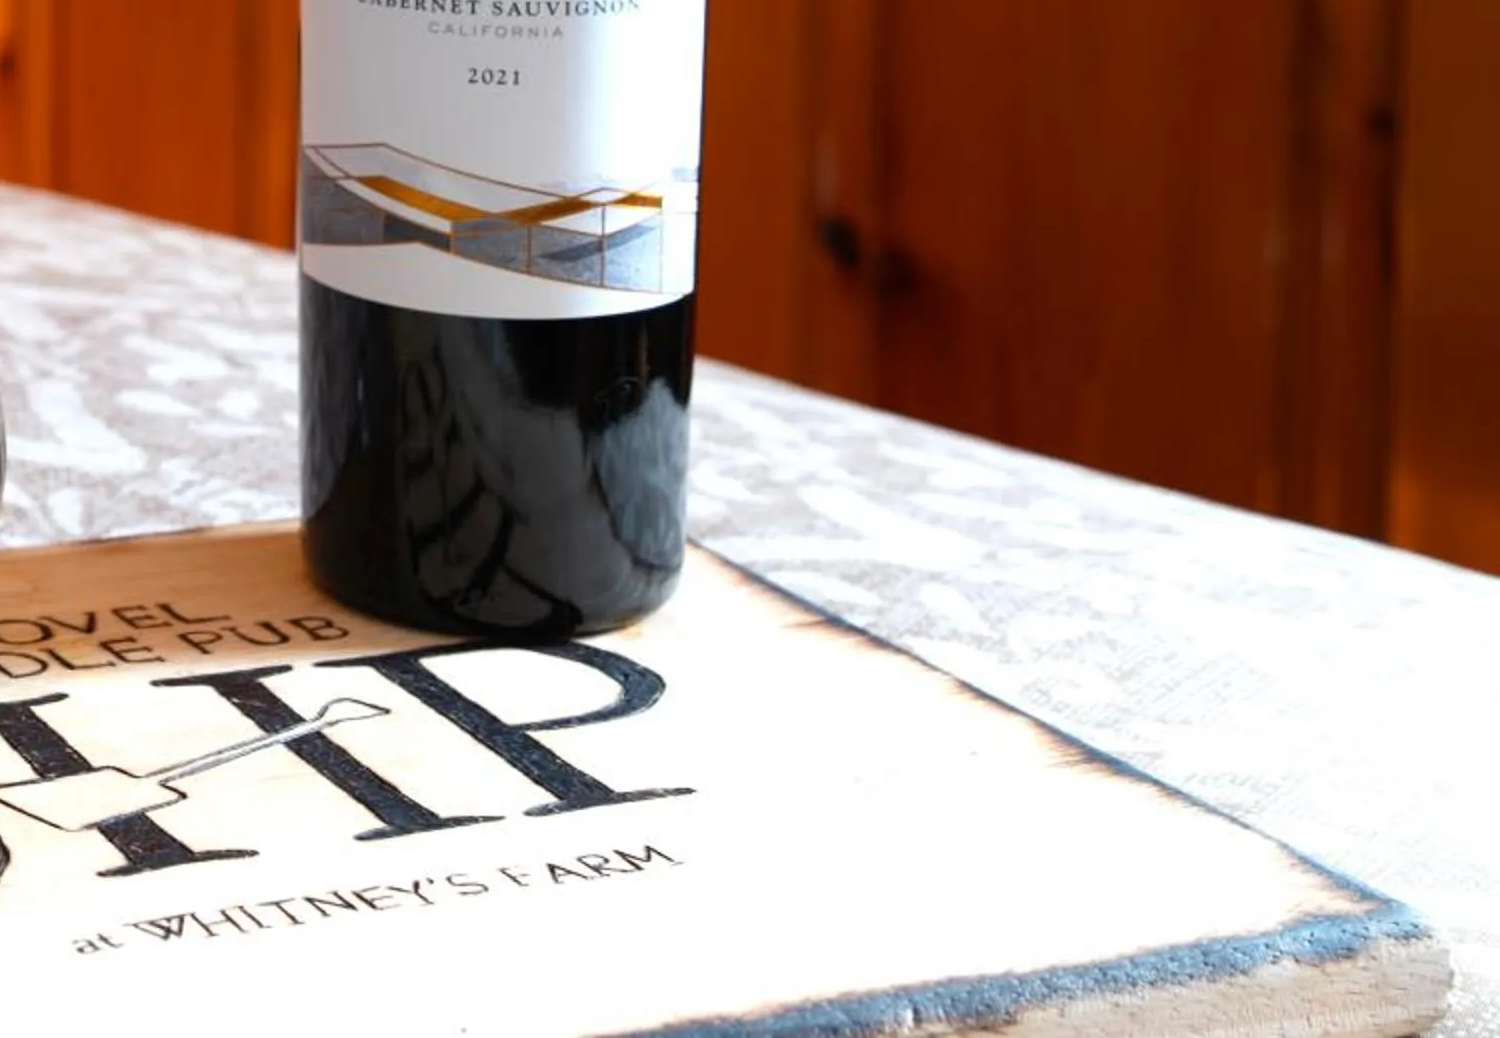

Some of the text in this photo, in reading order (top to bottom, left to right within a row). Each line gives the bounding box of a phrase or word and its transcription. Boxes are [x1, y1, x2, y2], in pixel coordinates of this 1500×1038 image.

[427, 21, 564, 38] CALIFORNIA
[467, 68, 520, 86] 2021
[177, 615, 351, 654] PUB
[73, 844, 685, 956] at WHITNEY'S FARM
